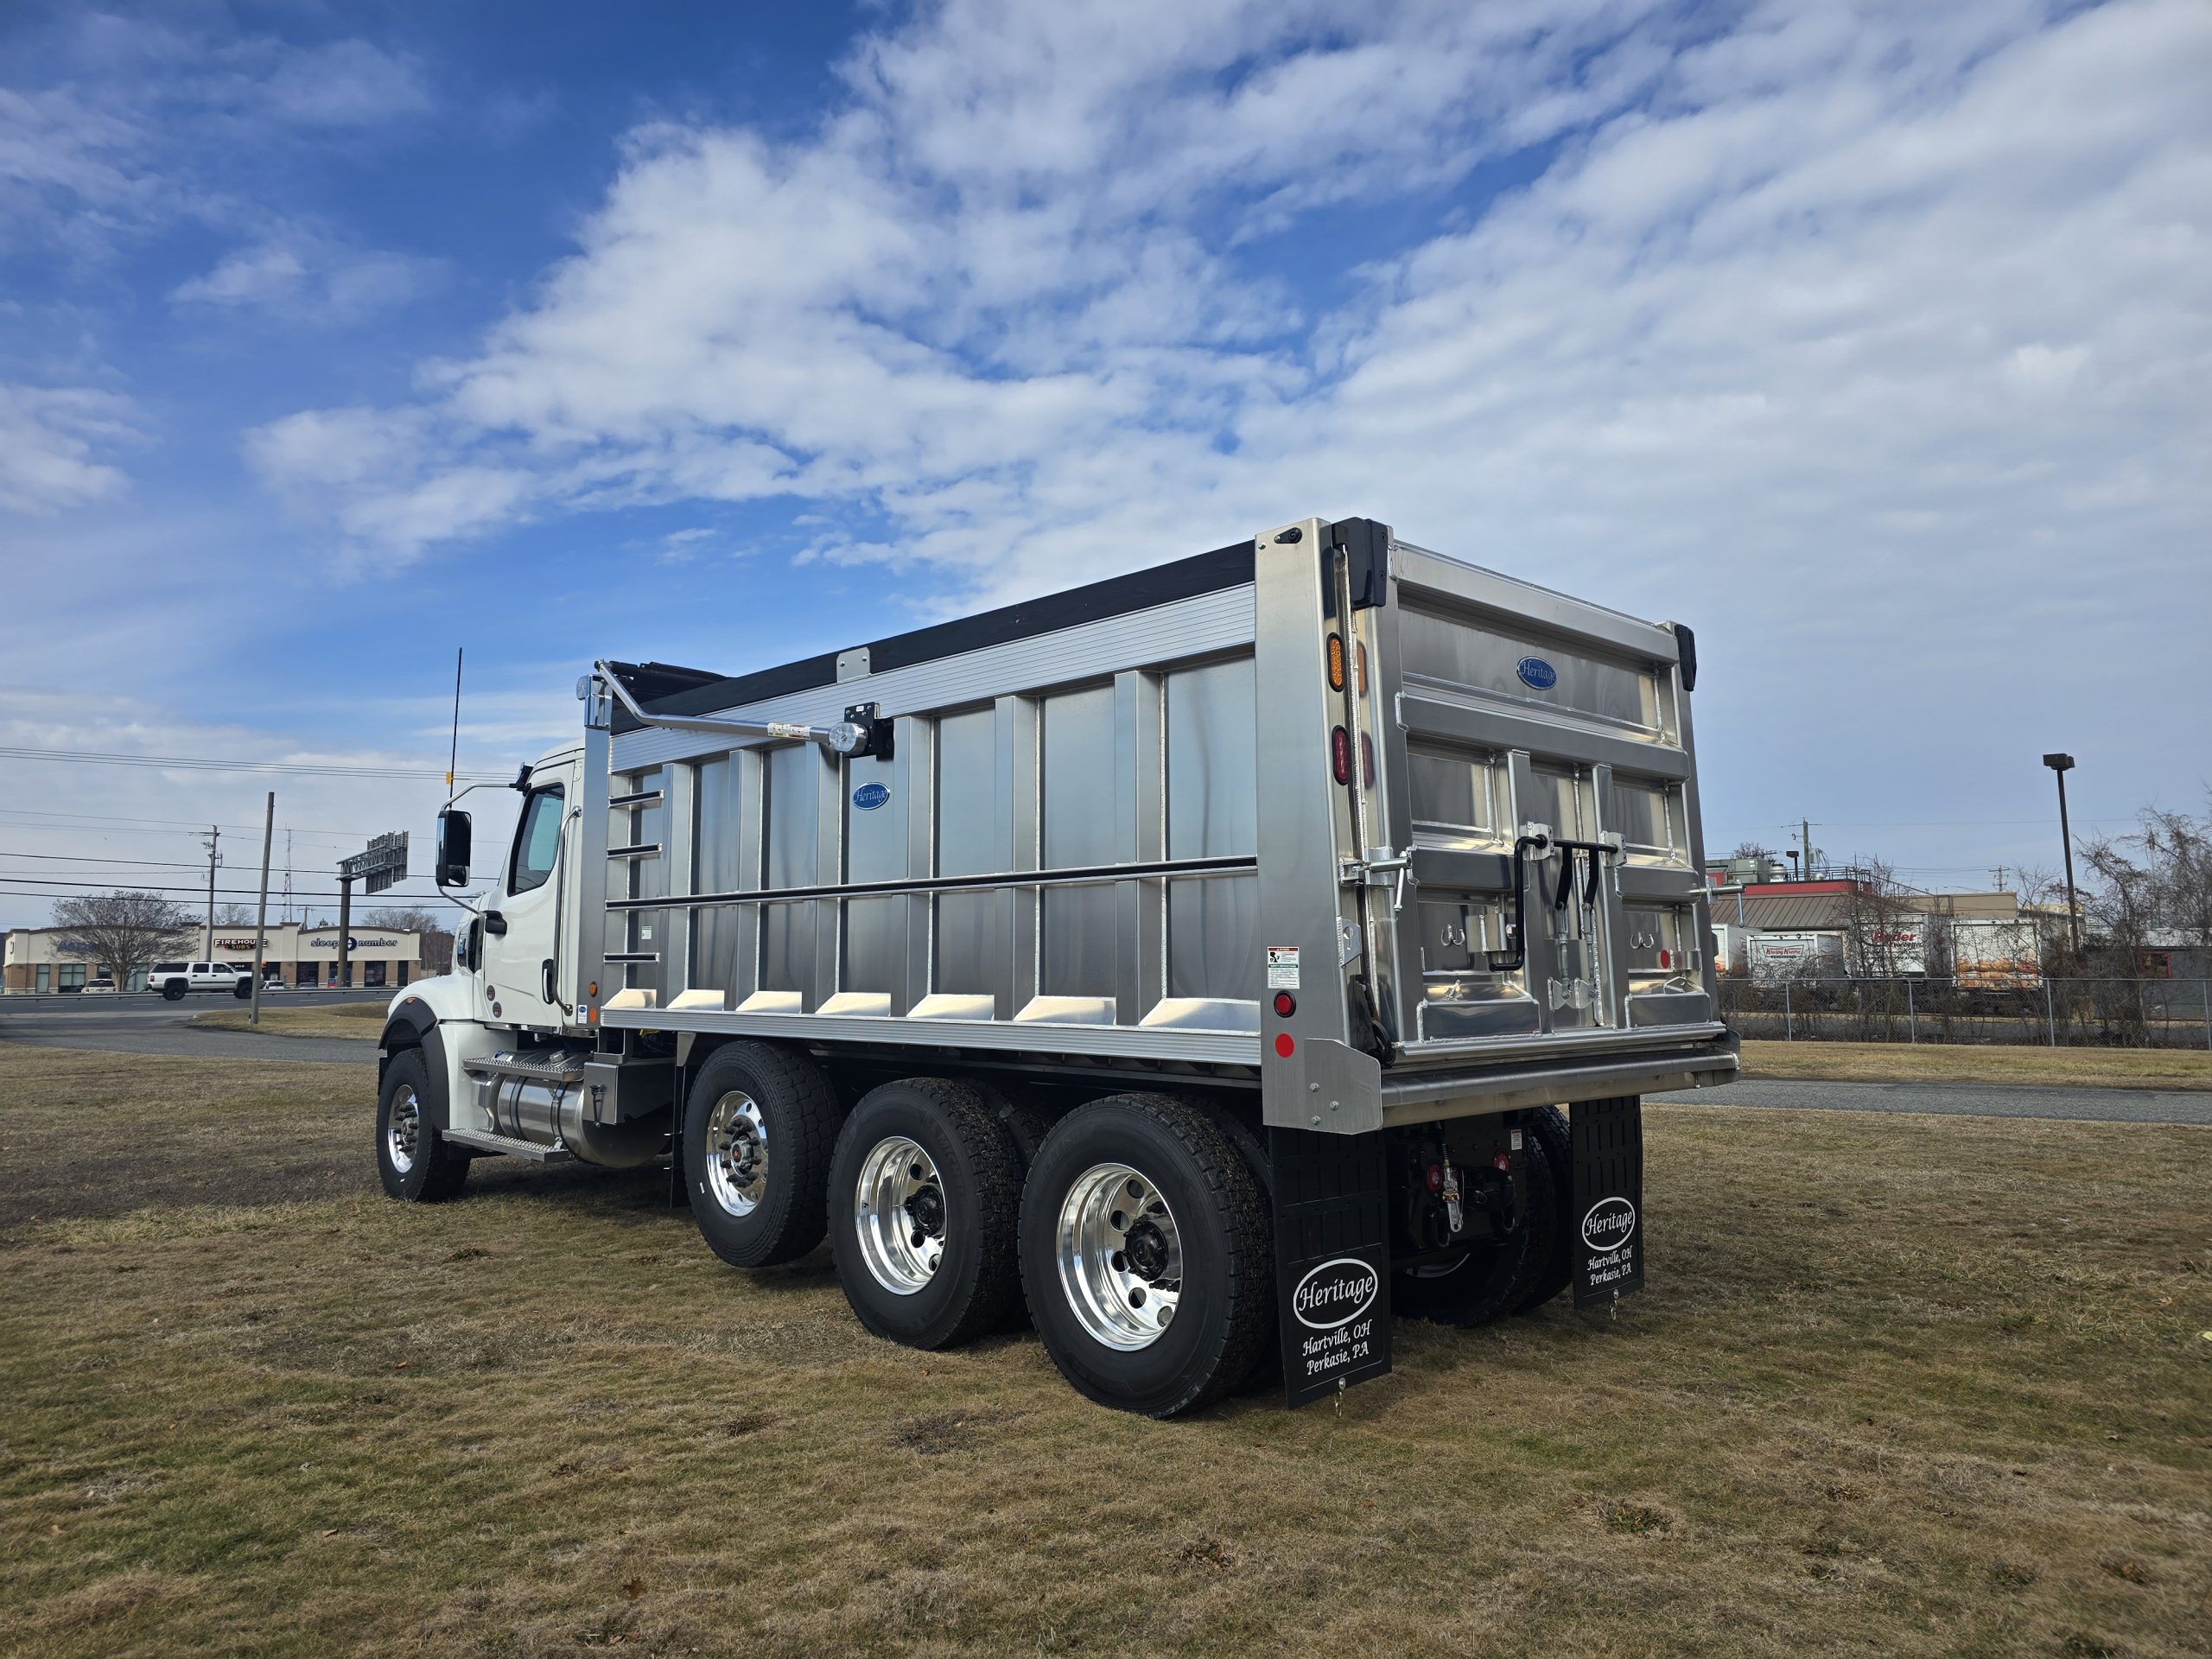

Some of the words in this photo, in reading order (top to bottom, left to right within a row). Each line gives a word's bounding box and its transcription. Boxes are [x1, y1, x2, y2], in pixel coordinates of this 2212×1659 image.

[1522, 661, 1555, 685] Heritage
[855, 787, 887, 803] Heritage
[311, 938, 339, 949] sleep
[1586, 1211, 1632, 1236] Heritage
[1586, 1250, 1621, 1270] Hartville,
[1622, 1245, 1633, 1260] OH
[1590, 1267, 1621, 1285] Perkasie,
[1621, 1262, 1631, 1275] PA
[1299, 1276, 1373, 1311] Heritage
[1302, 1327, 1351, 1356] Hartville,
[1353, 1319, 1372, 1338] OH
[1306, 1349, 1350, 1375] Perkasie,
[1352, 1341, 1369, 1358] PA
